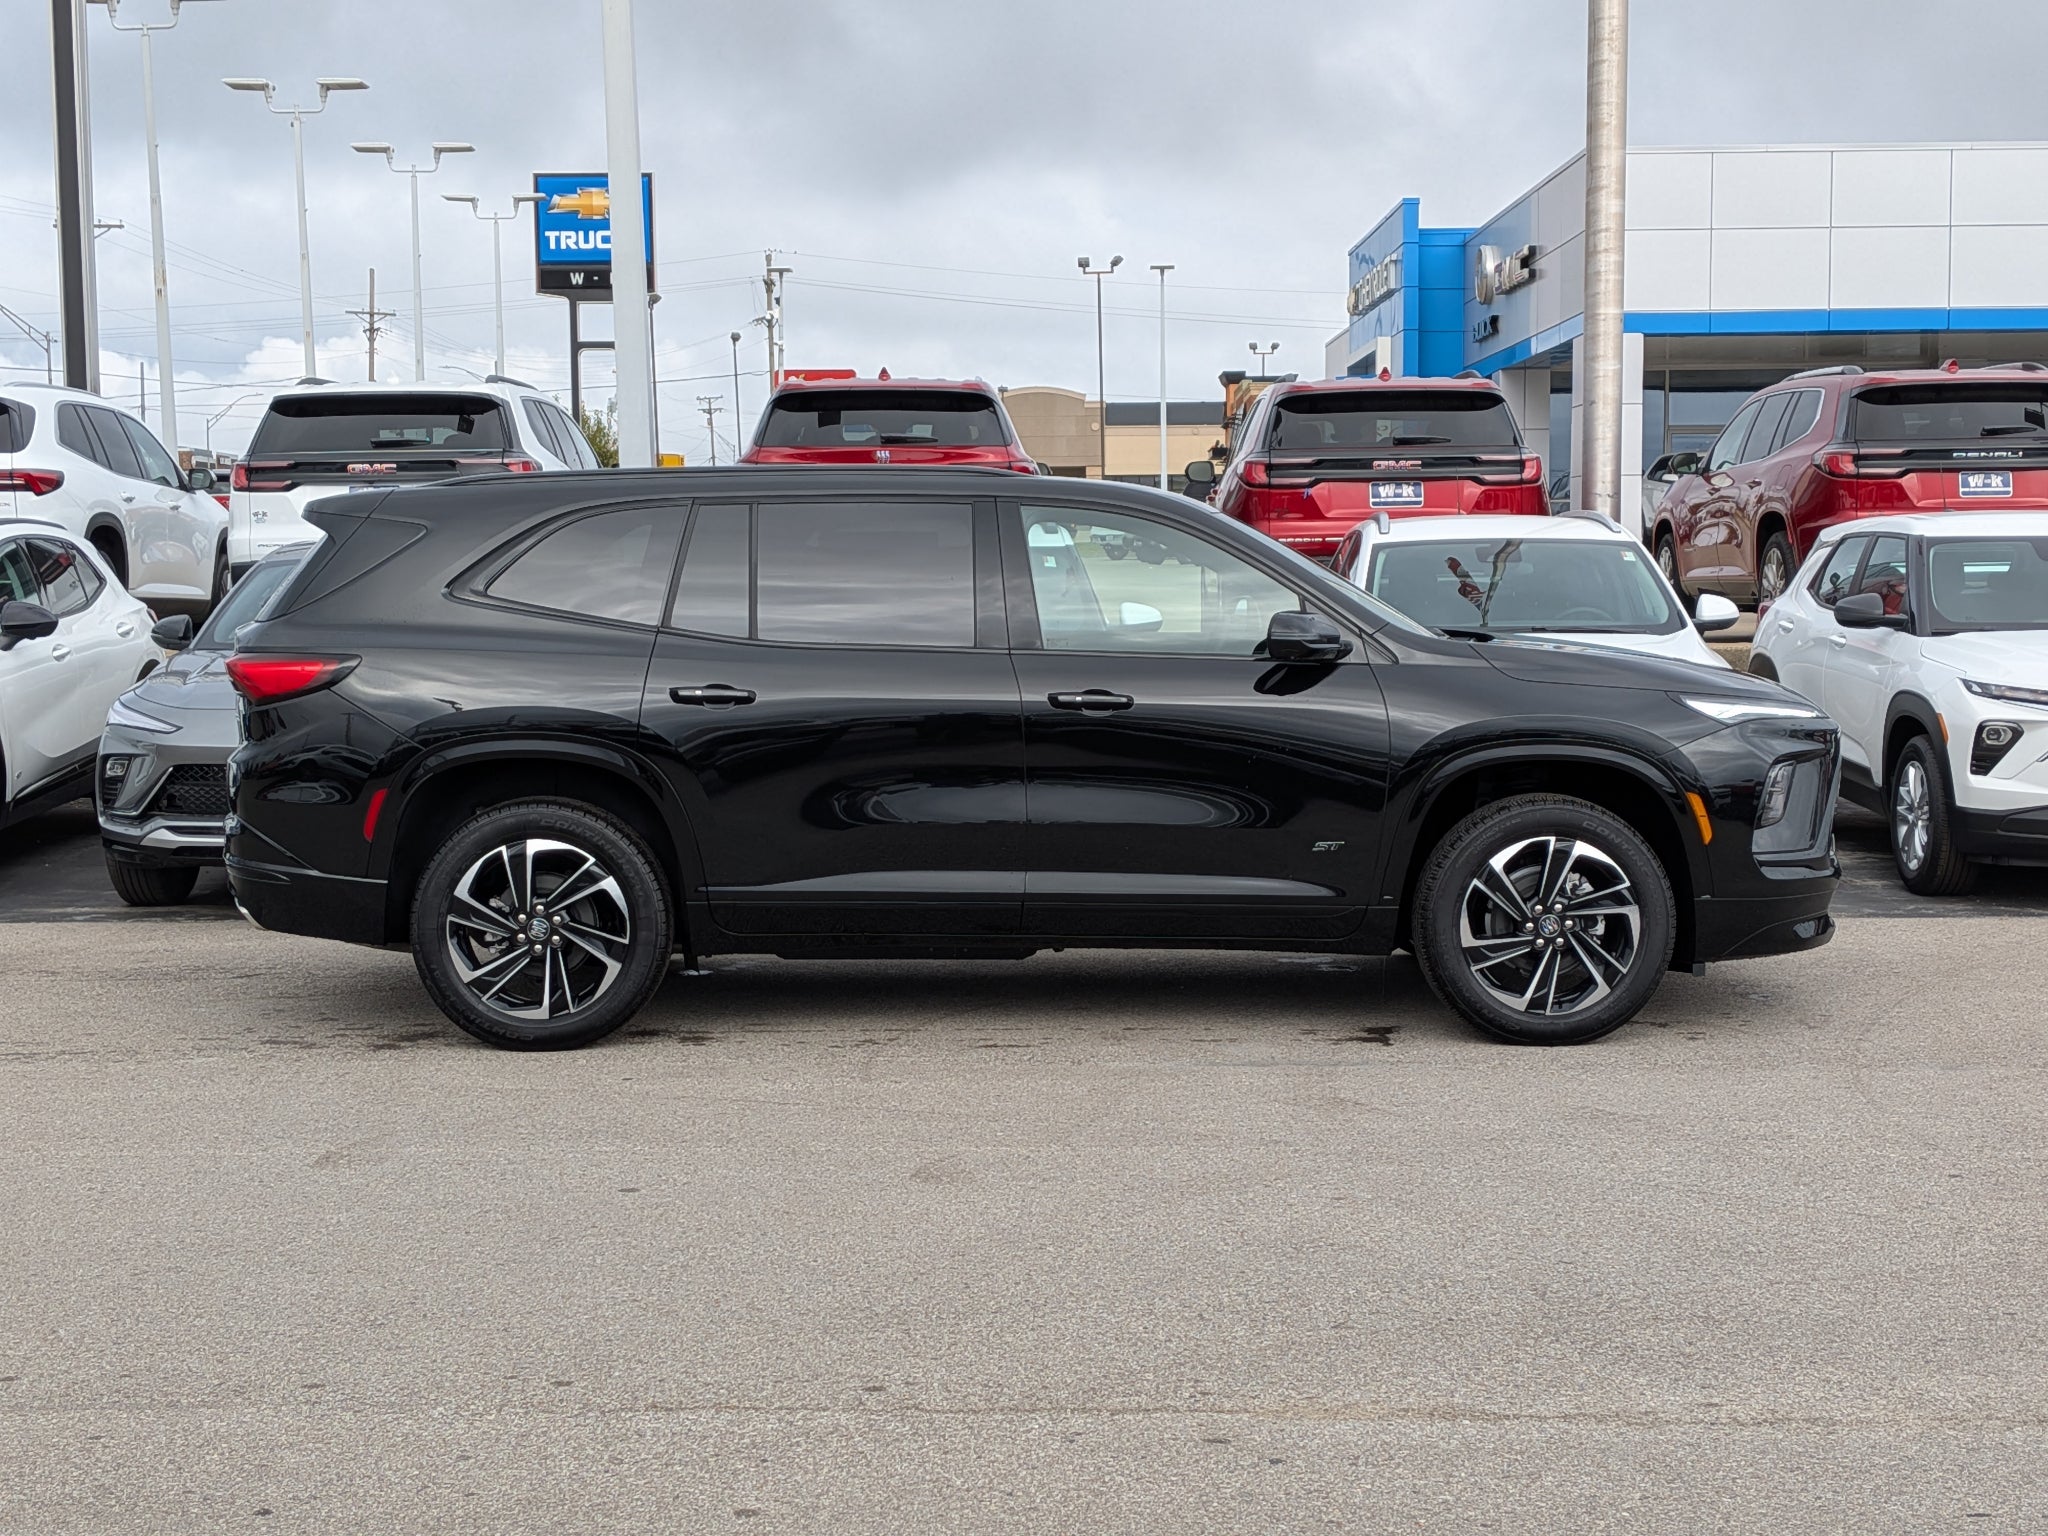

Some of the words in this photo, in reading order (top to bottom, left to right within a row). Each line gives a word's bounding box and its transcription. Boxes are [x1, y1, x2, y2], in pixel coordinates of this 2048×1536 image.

[545, 231, 612, 250] TRUC
[346, 463, 398, 474] GMC
[1372, 459, 1423, 471] GMC
[1312, 841, 1345, 851] ST
